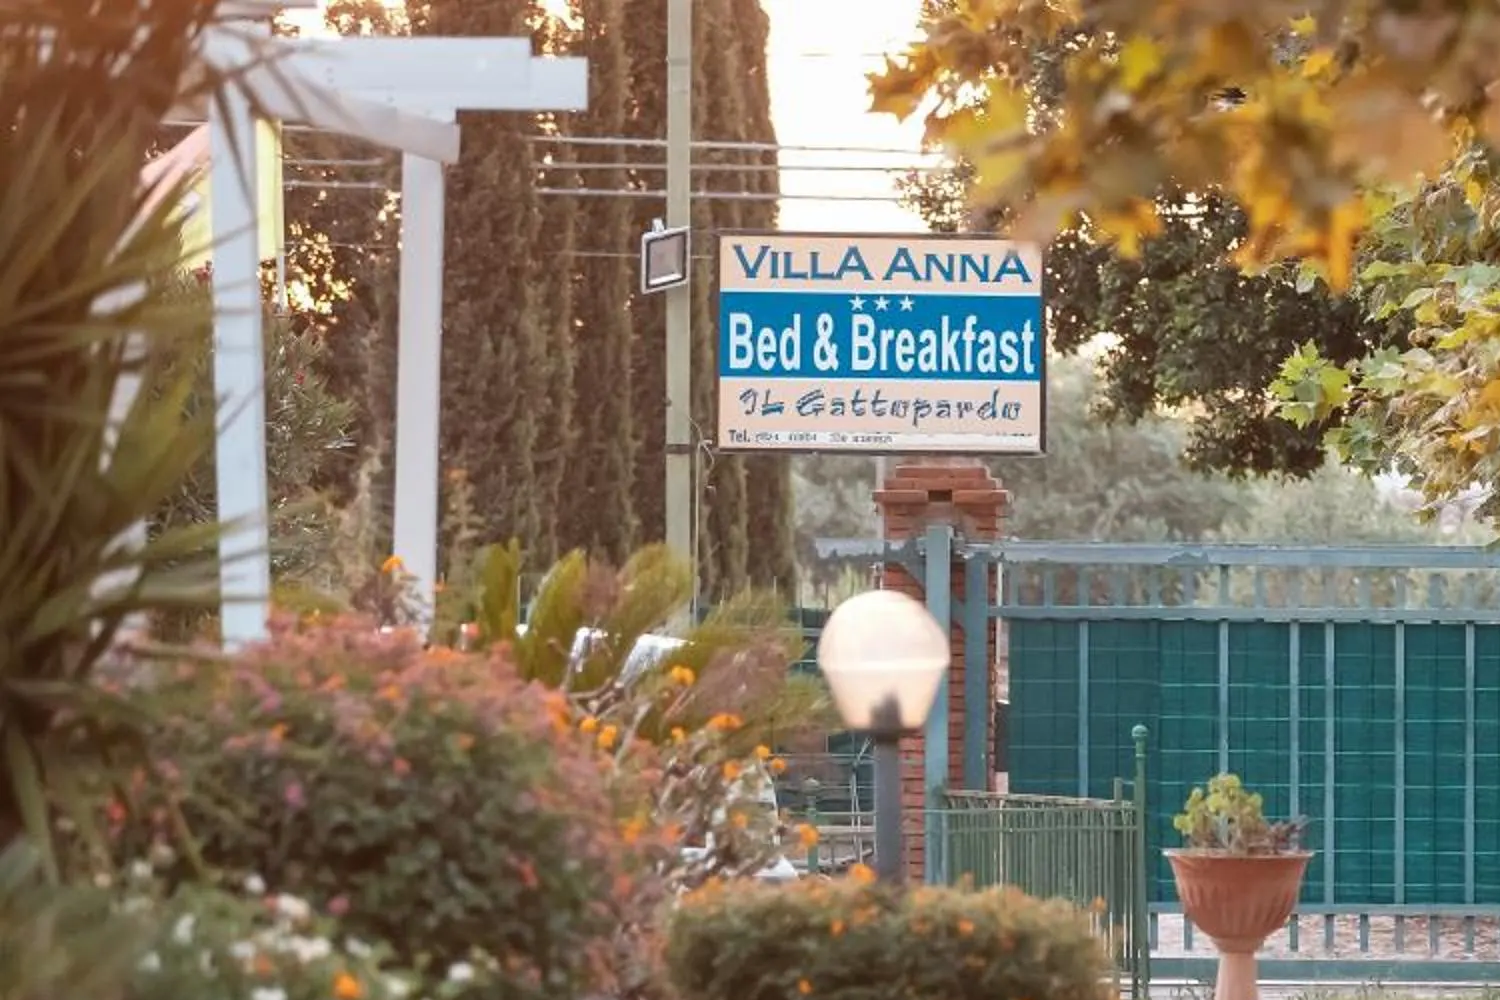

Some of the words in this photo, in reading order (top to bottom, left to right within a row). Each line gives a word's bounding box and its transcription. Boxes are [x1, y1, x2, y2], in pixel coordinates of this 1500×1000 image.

[733, 245, 873, 280] VILLA
[882, 247, 1032, 282] ANNA
[728, 312, 801, 370] Bed
[813, 313, 839, 371] &
[850, 313, 1035, 373] Breakfast
[795, 389, 1022, 427] Gattopardo
[728, 429, 750, 442] Tel.
